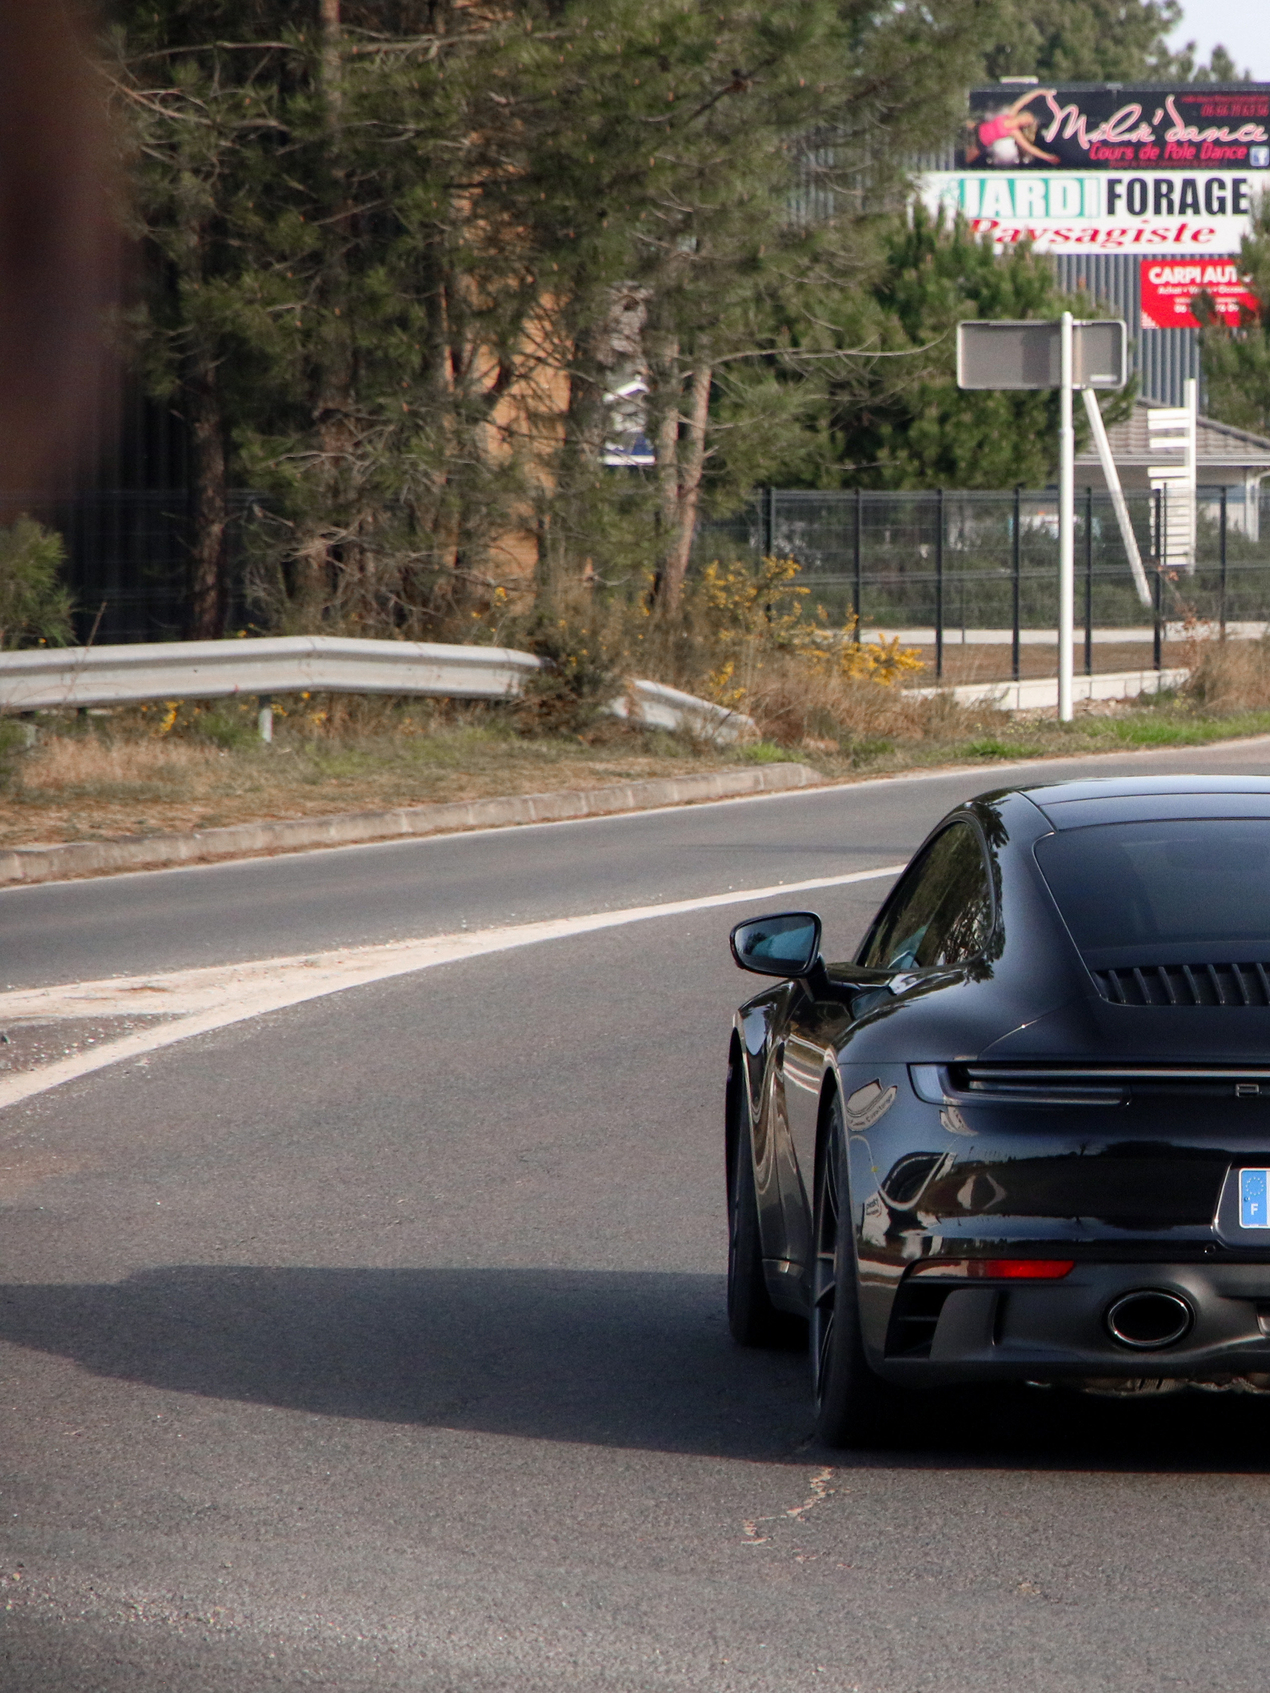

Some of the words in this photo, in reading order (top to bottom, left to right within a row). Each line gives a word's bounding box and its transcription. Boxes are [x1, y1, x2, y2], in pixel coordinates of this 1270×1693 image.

[1089, 142, 1134, 160] Cours
[1138, 142, 1160, 160] de
[1164, 142, 1197, 160] Pole
[1200, 141, 1248, 160] Dance
[1107, 177, 1249, 218] FORAGE
[1148, 266, 1201, 285] CARPI
[1250, 1204, 1258, 1215] F
